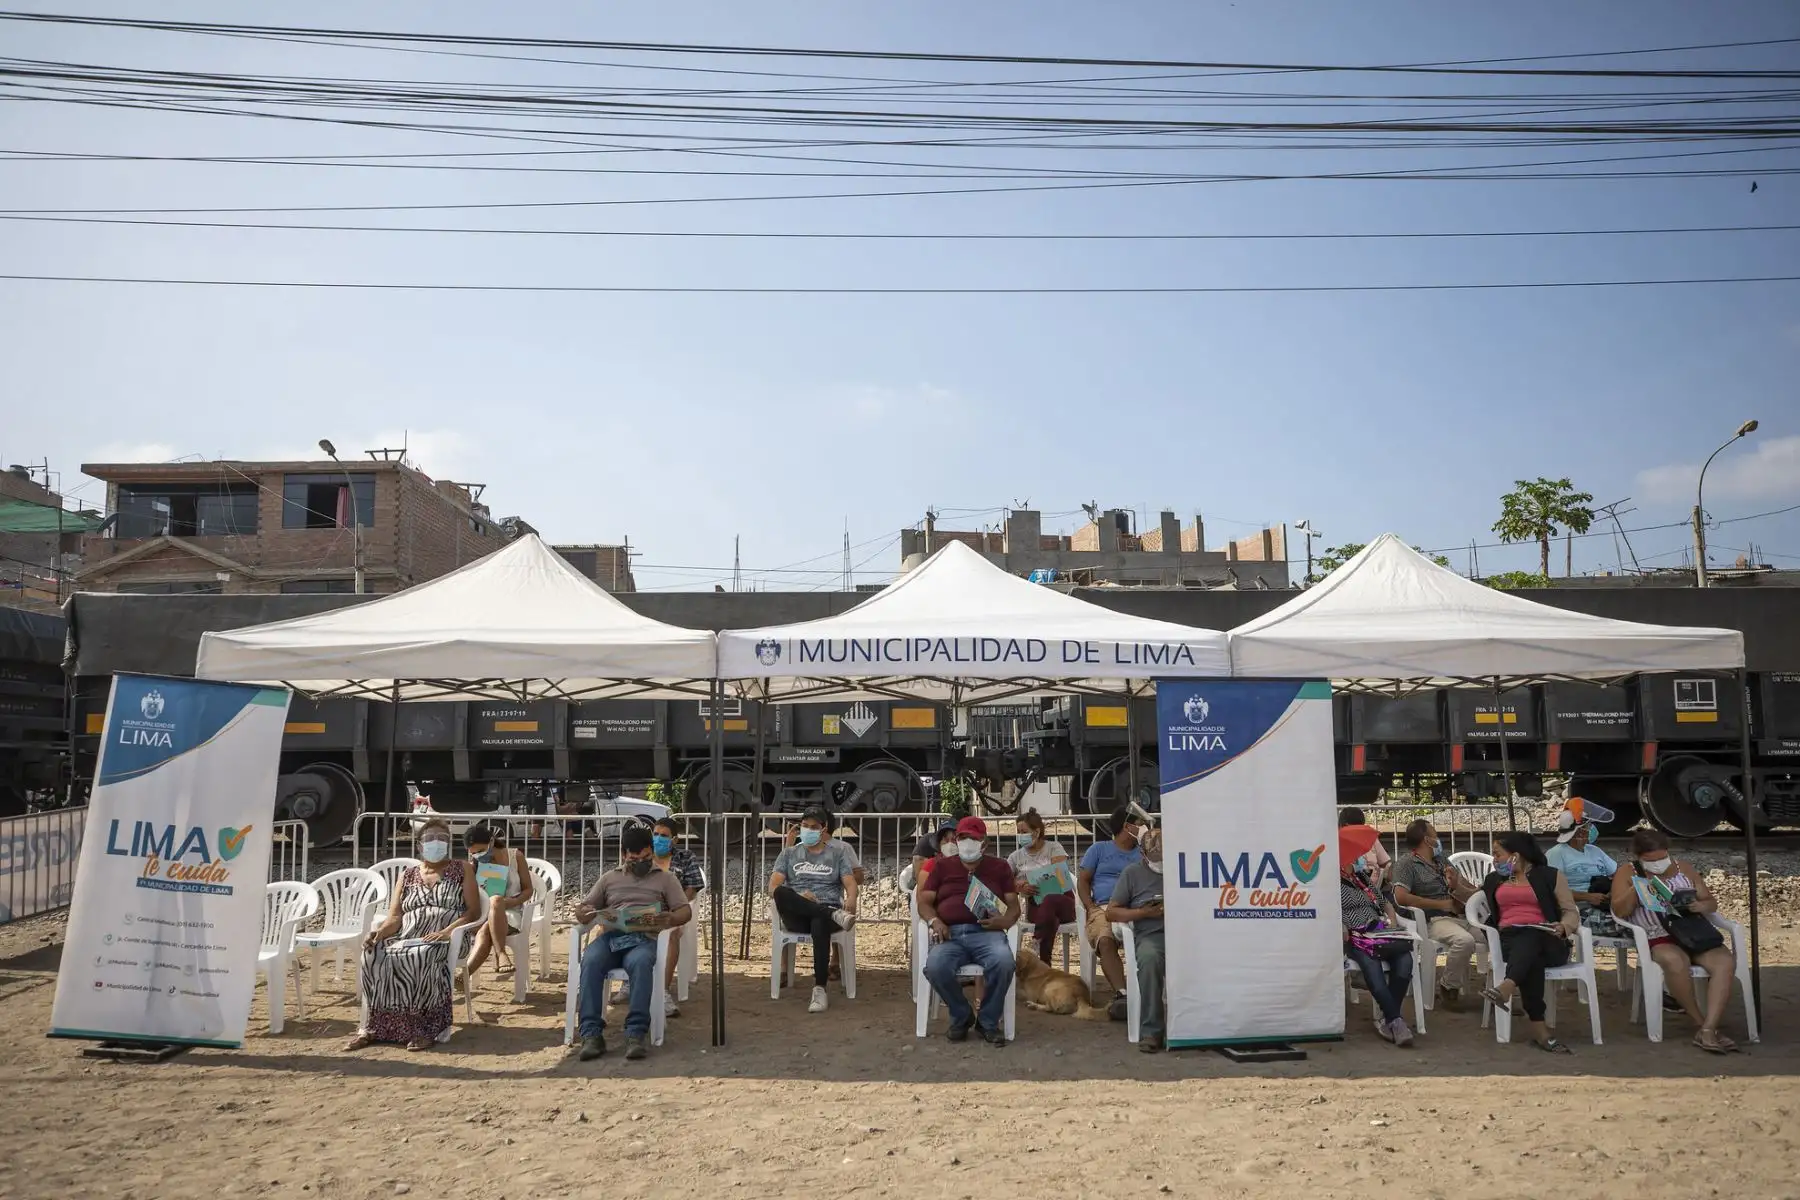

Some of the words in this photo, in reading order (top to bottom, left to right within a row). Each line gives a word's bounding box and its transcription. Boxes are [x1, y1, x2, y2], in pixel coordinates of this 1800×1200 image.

[800, 637, 1047, 663] MUNICIPALIDAD
[1062, 641, 1100, 663] DE
[1115, 643, 1195, 666] LIMA
[123, 719, 166, 728] MUNICIPALIDAD
[120, 729, 173, 748] LIMA
[1169, 735, 1227, 750] LIMA
[106, 819, 211, 864] LIMA
[166, 858, 230, 884] cuida
[1178, 852, 1289, 888] LIMA
[149, 881, 198, 893] MUNICIPALIDAD
[200, 885, 210, 893] DE
[211, 886, 230, 895] LIMA
[1250, 881, 1311, 911] cuida
